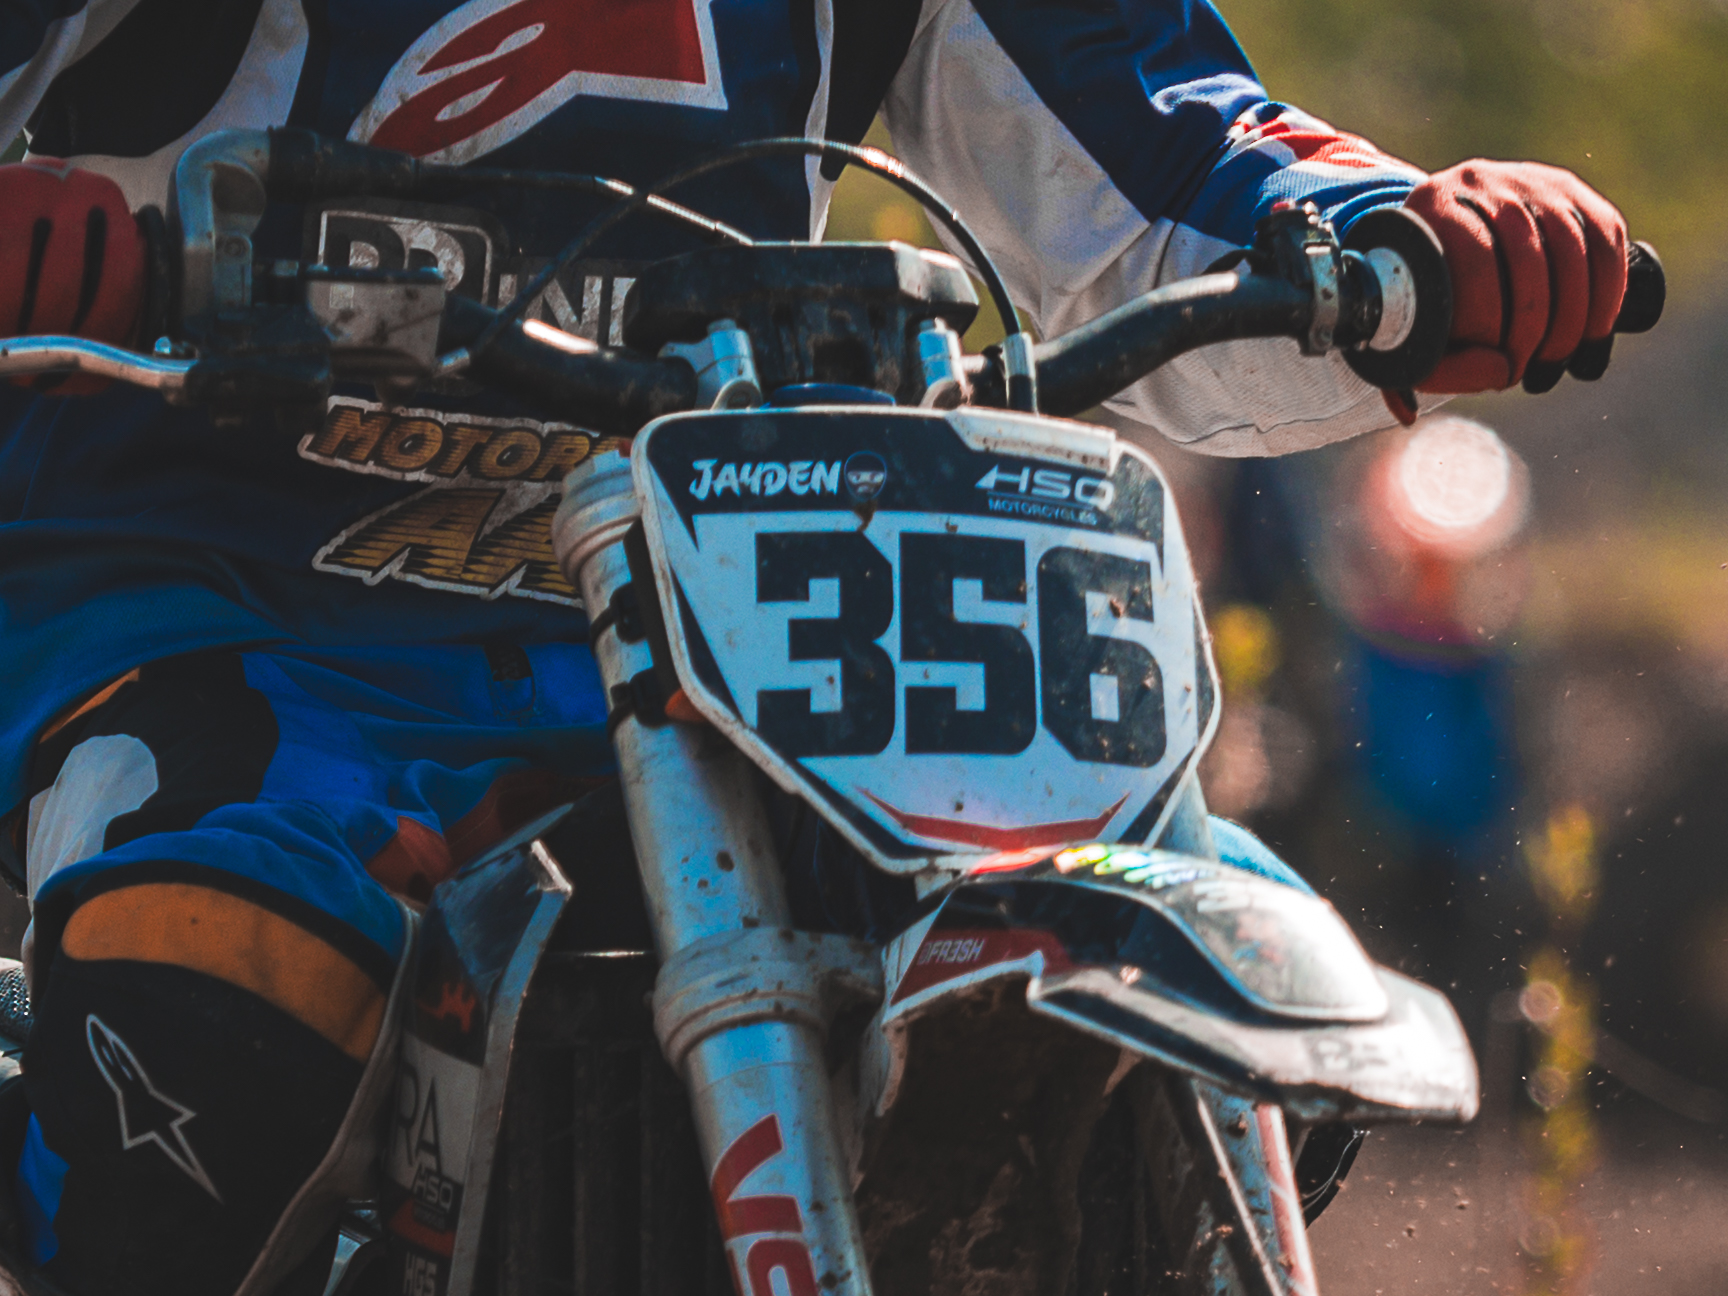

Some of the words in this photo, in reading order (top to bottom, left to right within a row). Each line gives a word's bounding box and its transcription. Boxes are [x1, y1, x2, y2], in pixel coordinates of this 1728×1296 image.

[306, 405, 622, 480] MOTOR
[689, 458, 841, 501] JAYDEN
[755, 530, 1167, 768] 356
